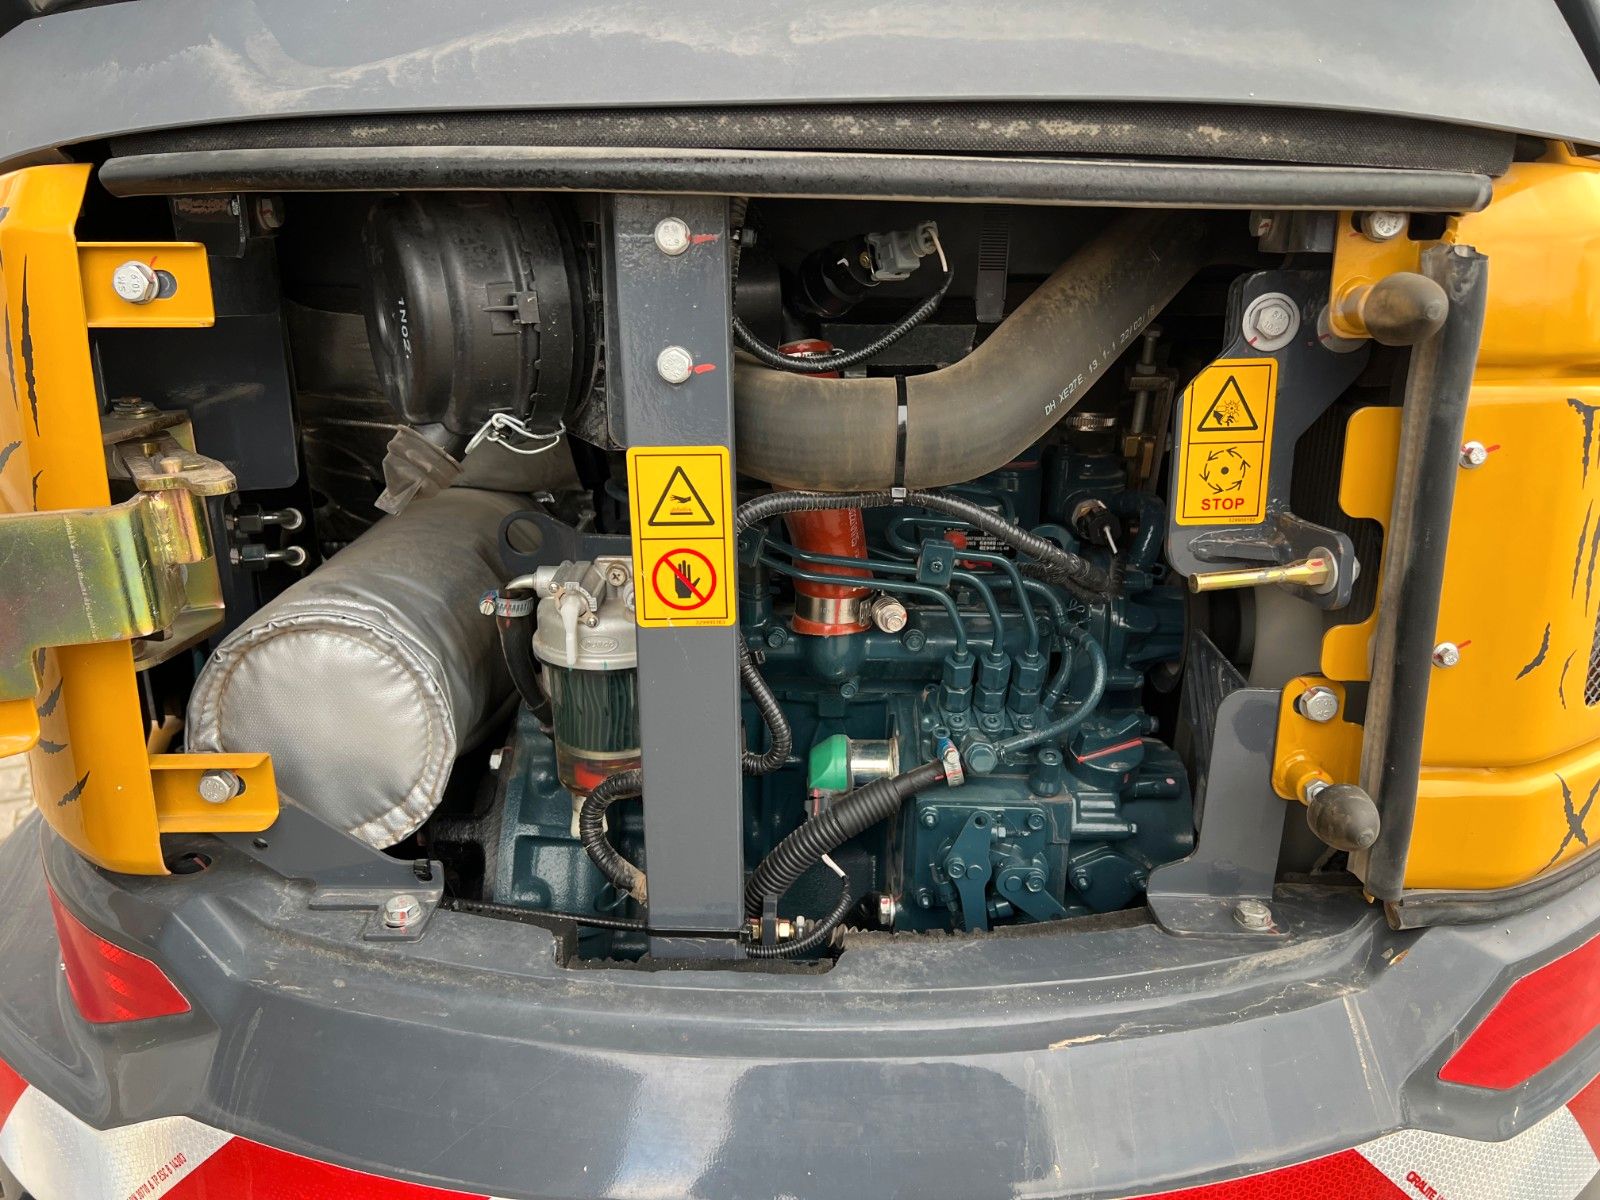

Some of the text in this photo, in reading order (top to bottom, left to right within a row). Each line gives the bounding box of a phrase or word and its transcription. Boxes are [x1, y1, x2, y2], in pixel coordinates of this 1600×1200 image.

[1045, 400, 1056, 416] DH
[1201, 498, 1245, 510] STOP
[1407, 1171, 1438, 1200] ORALITE
